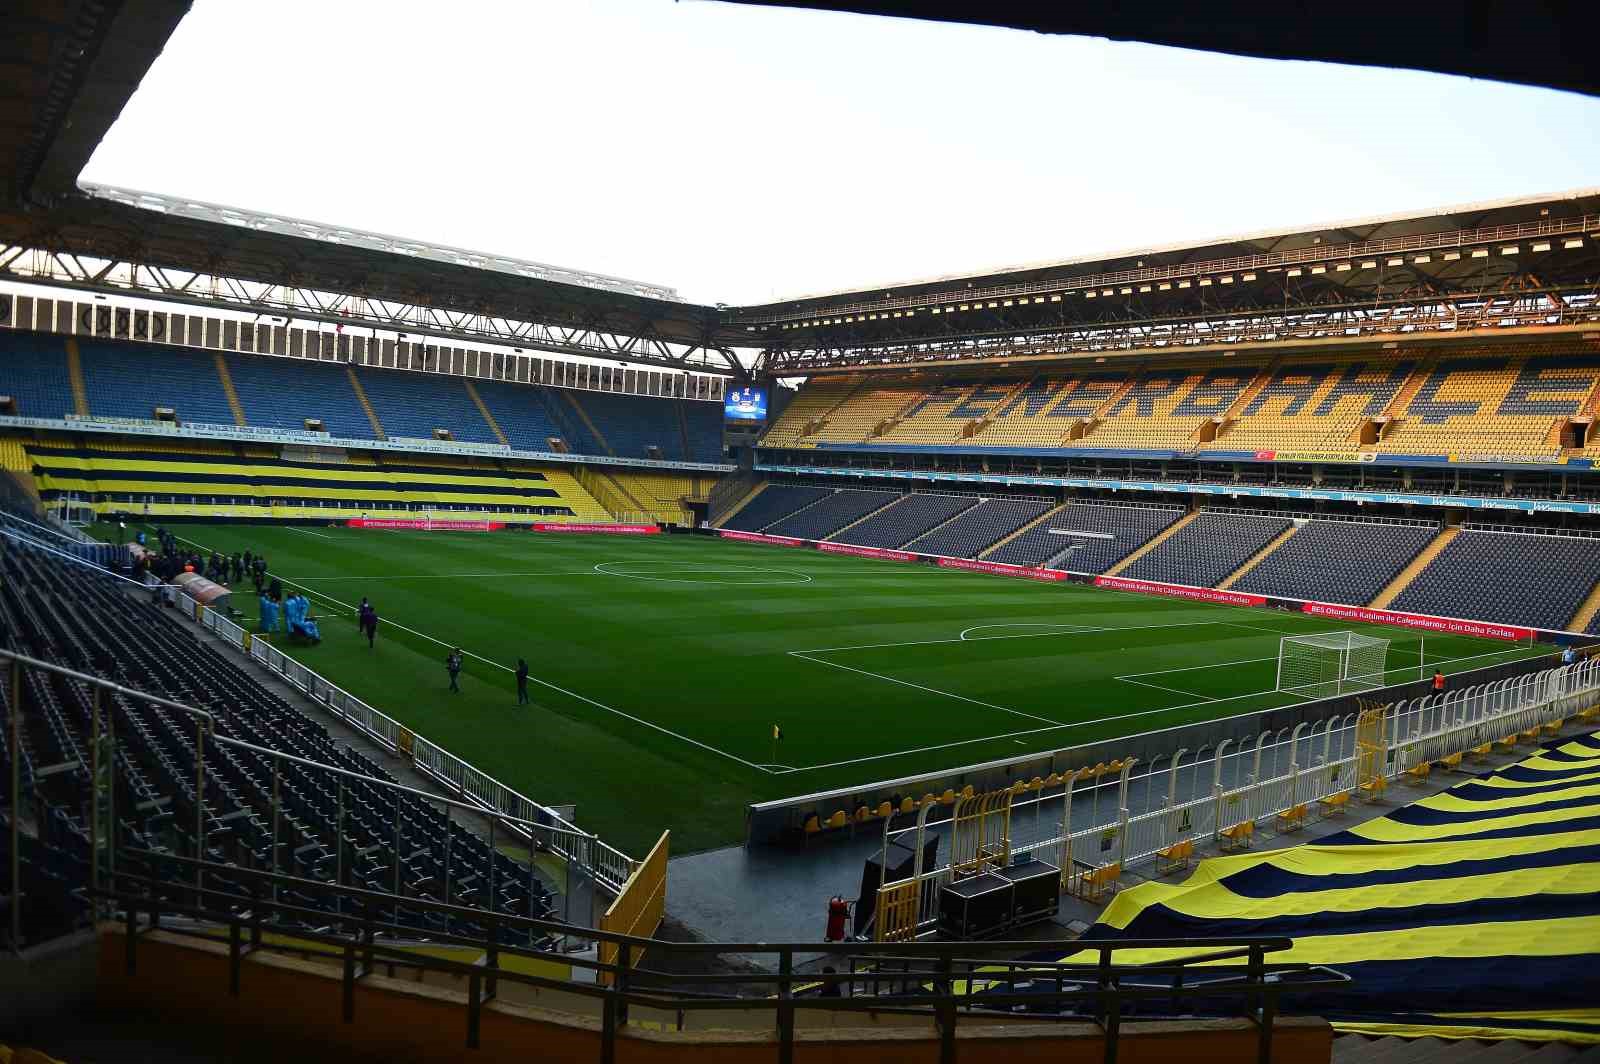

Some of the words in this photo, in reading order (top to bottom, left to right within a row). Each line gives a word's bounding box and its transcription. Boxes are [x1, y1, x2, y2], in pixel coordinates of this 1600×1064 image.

[1325, 607, 1358, 617] Otomatik
[1464, 625, 1485, 635] Daha
[1486, 627, 1515, 639] Fazlası
